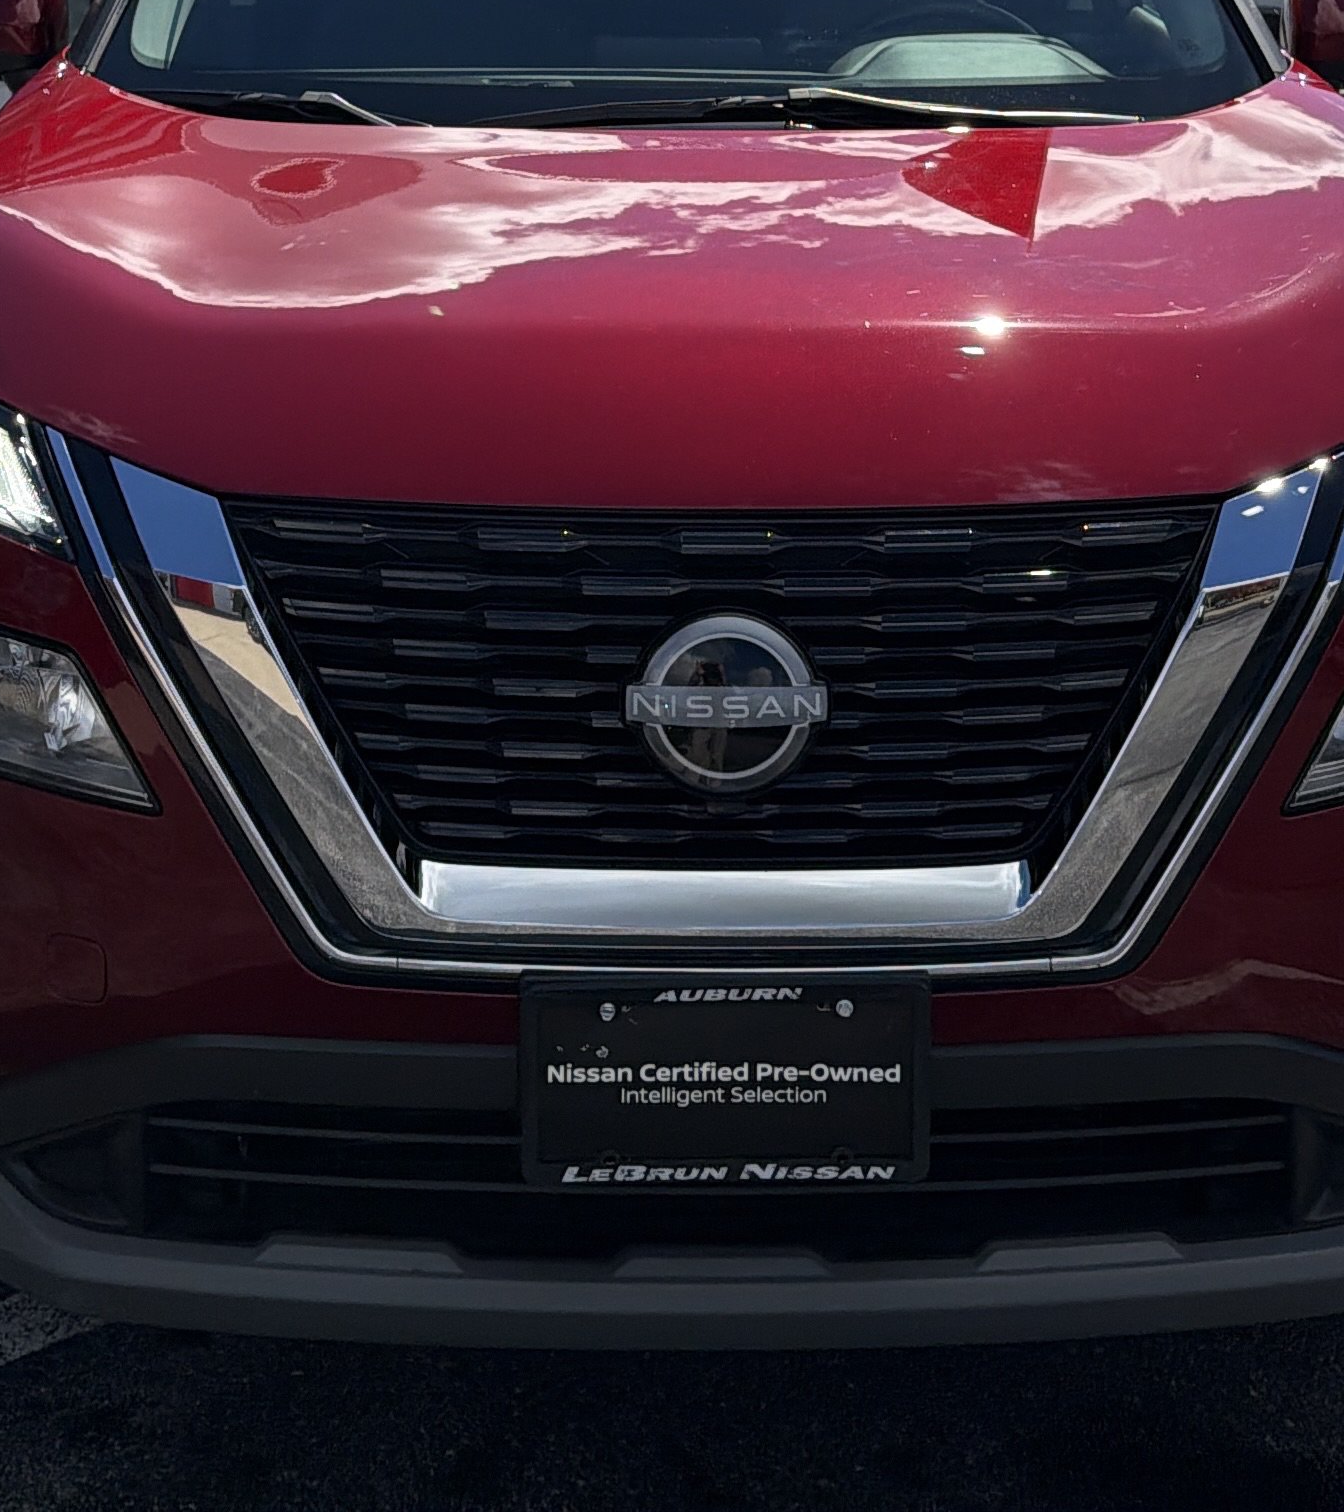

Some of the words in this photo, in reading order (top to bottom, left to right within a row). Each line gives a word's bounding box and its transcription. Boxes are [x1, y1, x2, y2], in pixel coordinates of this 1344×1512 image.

[632, 692, 822, 718] NISSAN
[653, 987, 803, 1003] AUBURN
[547, 1064, 633, 1084] Nissan
[639, 1062, 749, 1082] Certified
[756, 1062, 901, 1083] Pre-Owned
[621, 1087, 725, 1108] Intelligent
[731, 1086, 827, 1104] Selection
